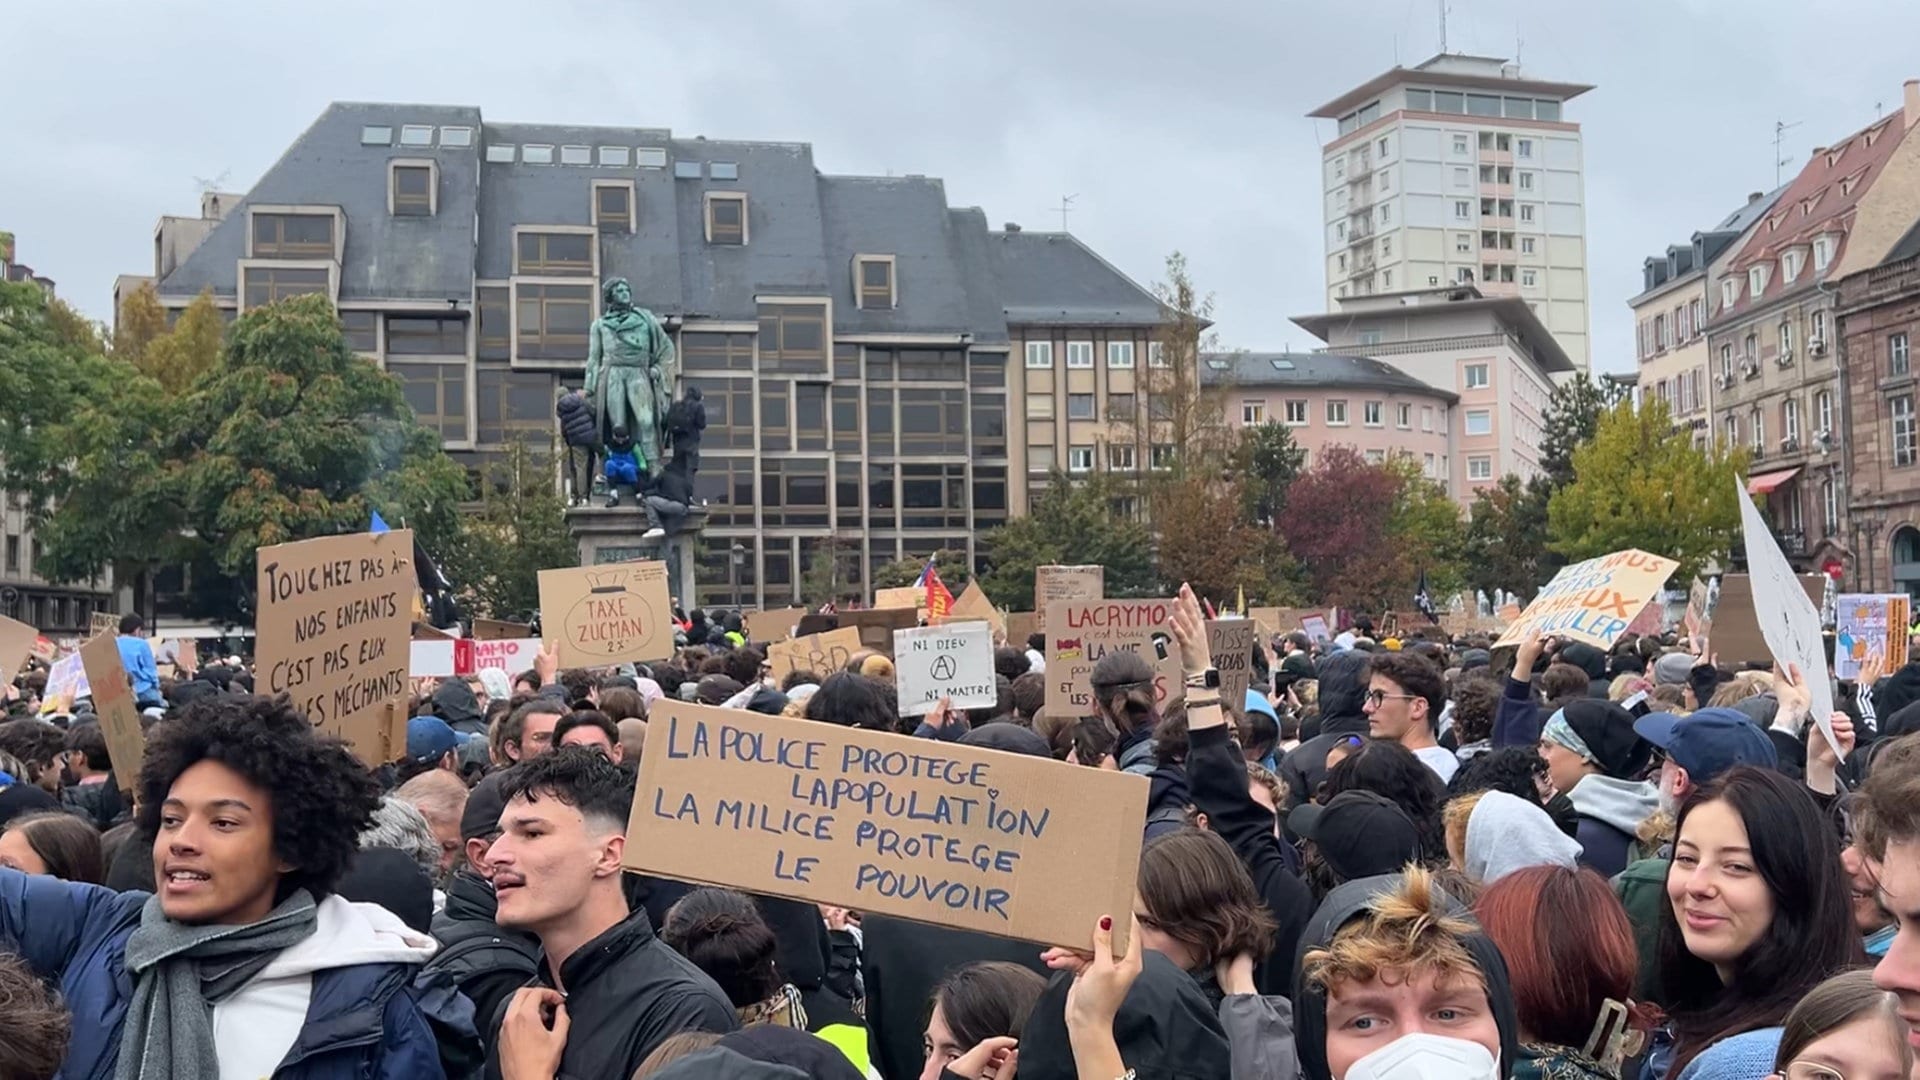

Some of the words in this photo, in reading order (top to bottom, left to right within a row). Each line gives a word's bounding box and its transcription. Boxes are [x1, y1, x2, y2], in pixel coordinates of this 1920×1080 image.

[264, 560, 352, 604] TOUCHEZ
[360, 556, 385, 582] PAS
[586, 597, 629, 619] TAXE
[1068, 604, 1167, 628] LACRYMO
[1545, 588, 1640, 618] MIEUX
[295, 611, 327, 644] NOS
[336, 592, 397, 630] ENFANTS
[577, 617, 643, 642] ZUCMAN
[913, 639, 928, 651] NI
[936, 638, 967, 650] DIEU
[1088, 643, 1107, 661] LA
[271, 656, 315, 694] C'EST
[323, 643, 349, 676] PAS
[359, 637, 386, 665] EUX
[334, 669, 404, 719] MÉCHANTS
[925, 689, 939, 701] NI
[1060, 682, 1074, 693] ET
[1070, 694, 1089, 705] LES
[719, 725, 826, 770] POLICE
[842, 745, 990, 787] PROTEGE
[655, 787, 700, 825] LA
[715, 799, 835, 840] MILICE
[856, 820, 1020, 872] PROTEGE
[774, 850, 820, 882] LE
[855, 864, 1010, 920] POUVOIR
